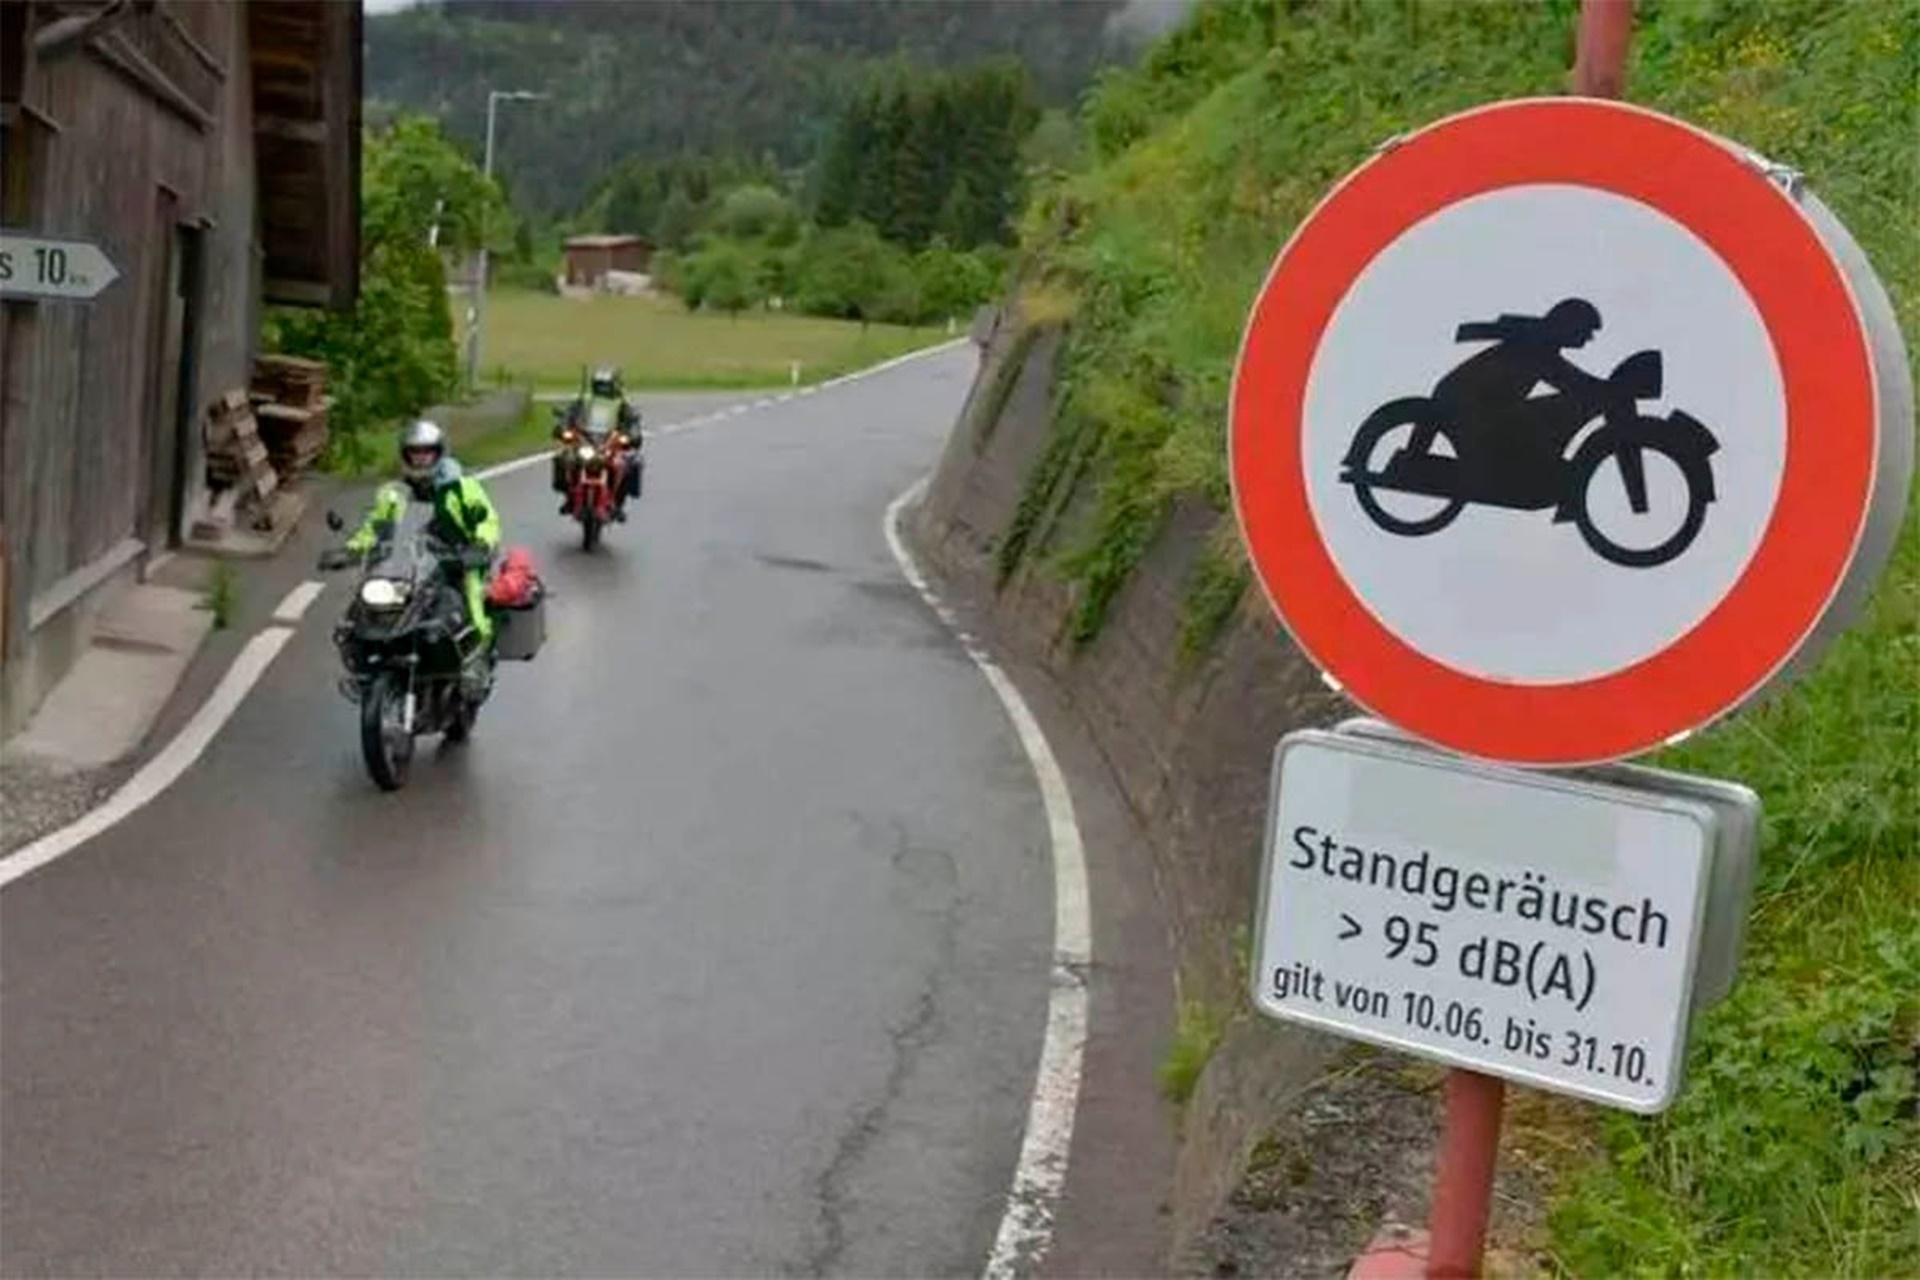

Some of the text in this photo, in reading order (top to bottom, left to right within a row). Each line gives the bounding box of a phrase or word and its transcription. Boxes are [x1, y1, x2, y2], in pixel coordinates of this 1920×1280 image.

[35, 249, 66, 284] 10
[1289, 825, 1669, 948] Standgeräusch
[1337, 913, 1597, 1012] > 95 dB(A)
[1273, 962, 1654, 1087] gilt von 10.06. bis 31.10.
